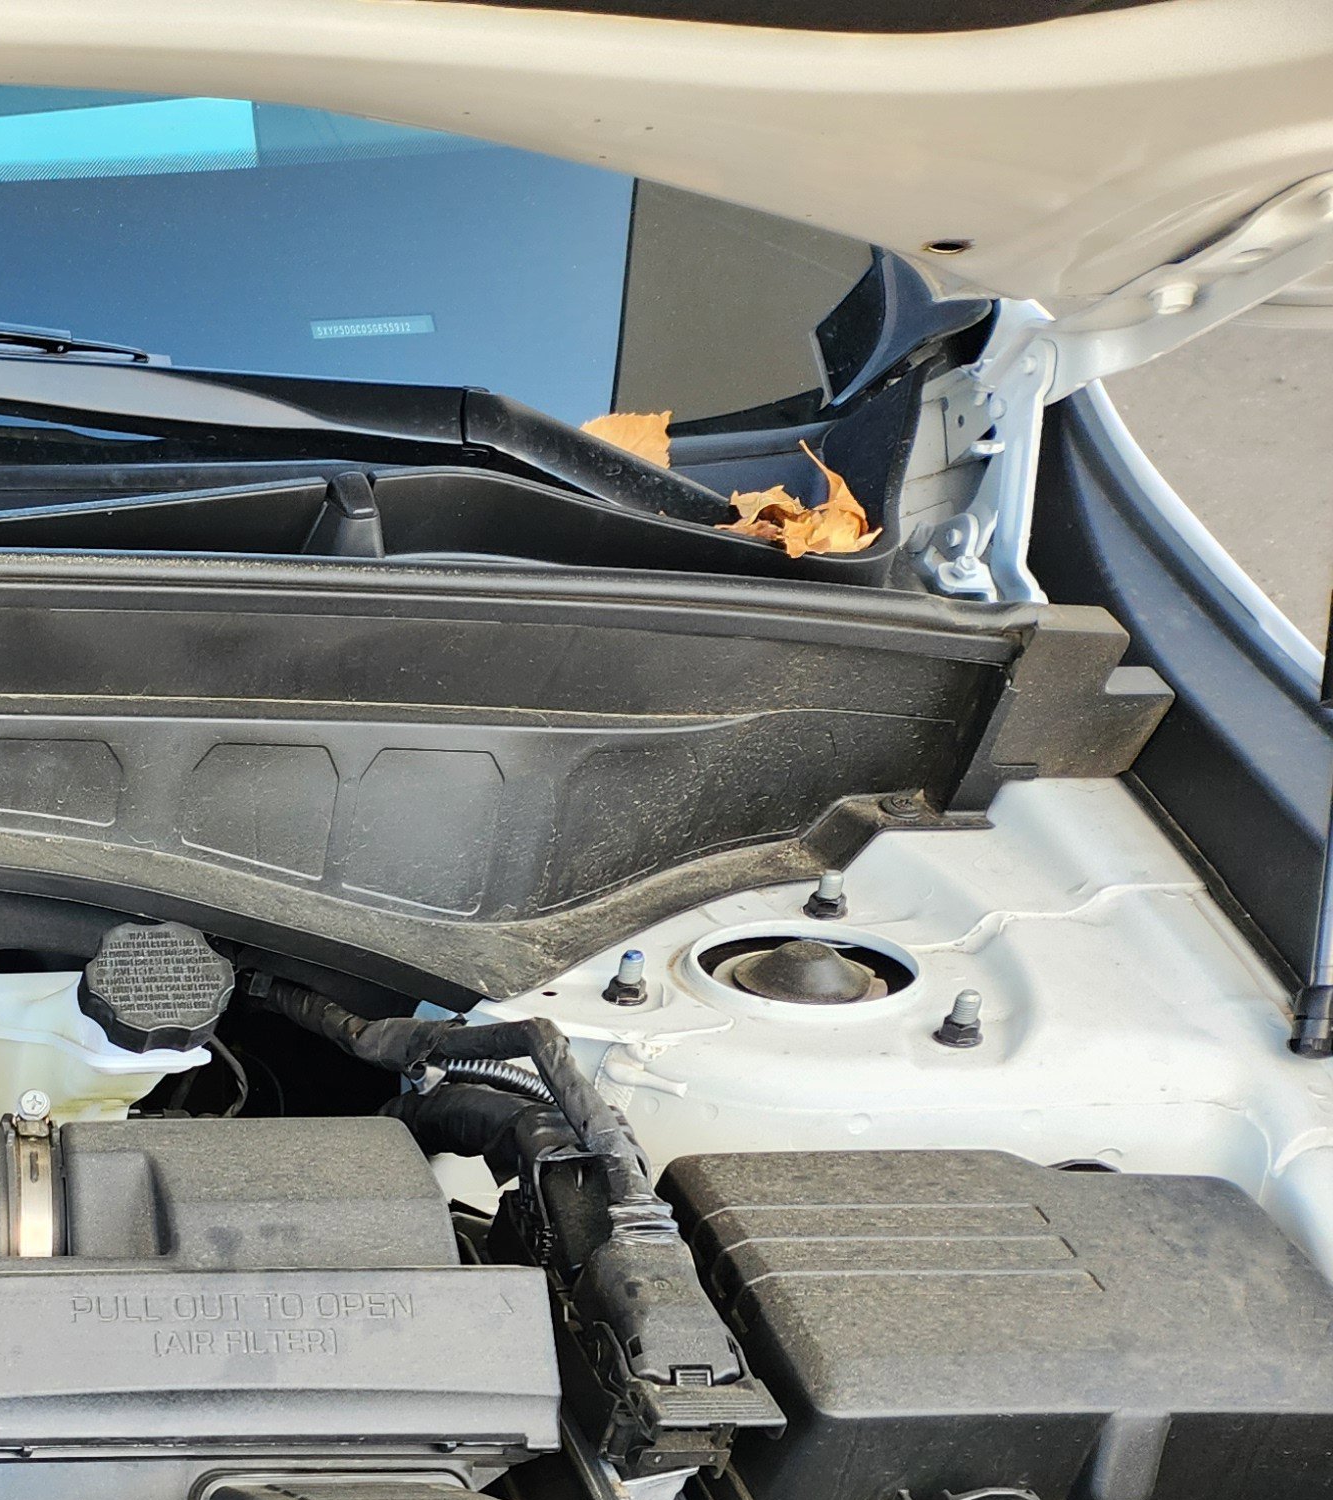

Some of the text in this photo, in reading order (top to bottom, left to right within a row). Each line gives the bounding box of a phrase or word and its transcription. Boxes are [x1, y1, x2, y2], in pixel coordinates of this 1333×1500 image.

[70, 1292, 417, 1324] PULL OUT TO OPEN
